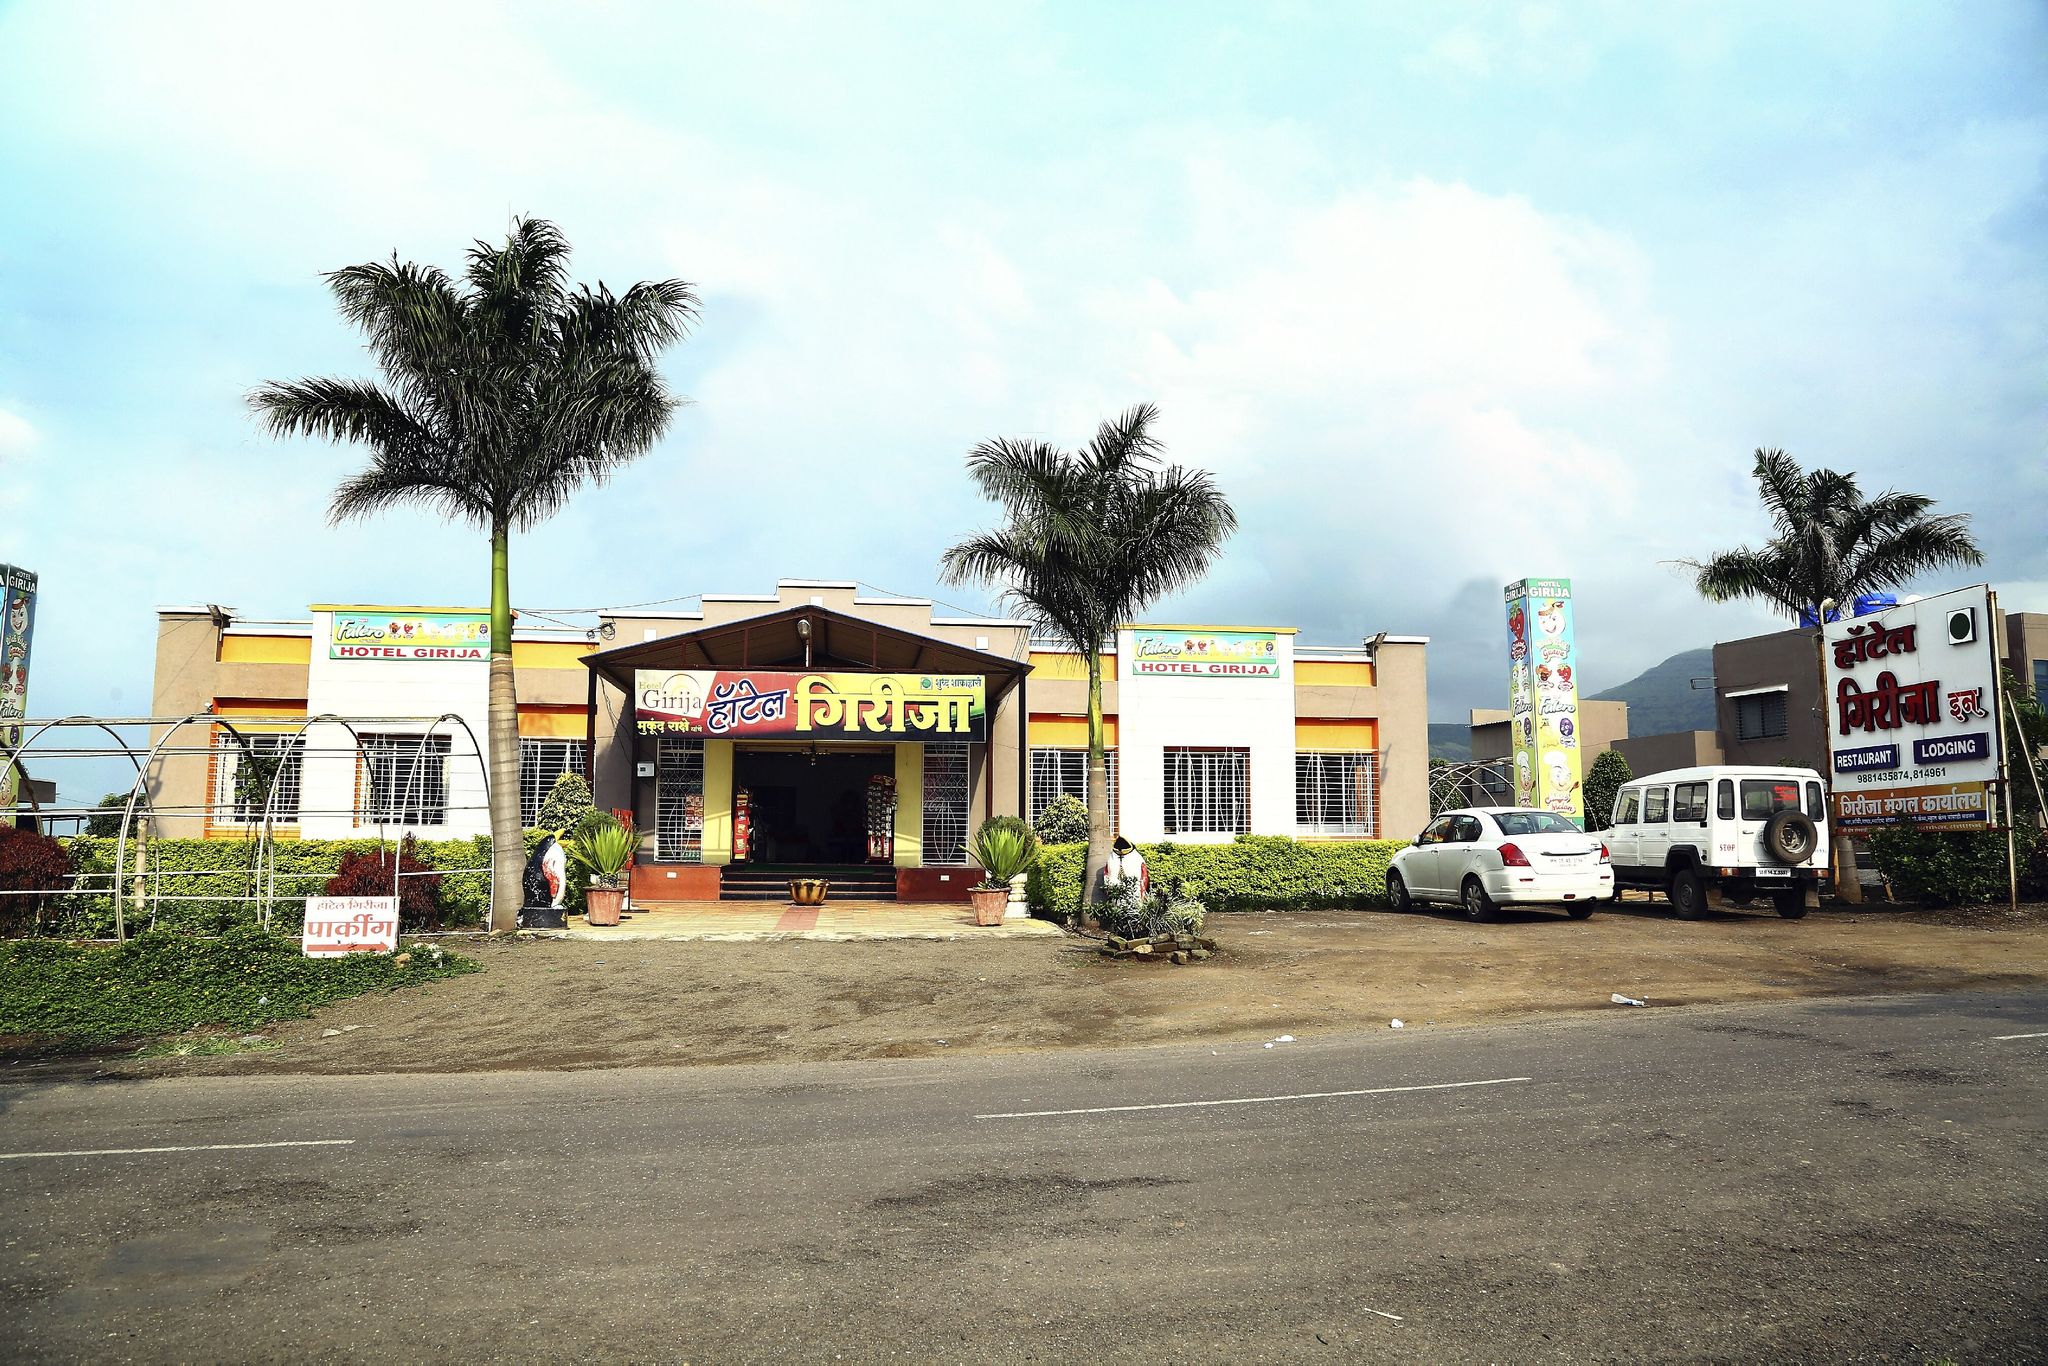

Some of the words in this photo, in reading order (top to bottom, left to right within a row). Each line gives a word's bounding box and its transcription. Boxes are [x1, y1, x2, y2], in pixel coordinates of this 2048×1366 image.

[16, 571, 32, 581] HOTEL
[9, 575, 36, 594] GIRIJA
[1530, 587, 1570, 597] GIRIJA
[1505, 588, 1526, 601] GIRIJA
[341, 647, 407, 657] HOTEL
[414, 648, 482, 658] GIRIJA
[1831, 621, 1917, 669] हॉटेल
[1141, 663, 1203, 673] HOTEL
[1208, 664, 1270, 674] GIRIJA
[639, 681, 662, 690] Hotel
[642, 690, 702, 714] Girija
[706, 679, 790, 732] हॉटेल
[793, 675, 975, 733] गिरीजा
[1836, 671, 1941, 736] गिरीजा
[1837, 750, 1892, 768] RESTAURANT
[1922, 739, 1976, 758] LODGING
[1840, 794, 1882, 816] गिरीजा
[1884, 792, 1919, 813] मंगल
[1921, 787, 1982, 812] कार्यालय
[1720, 843, 1735, 852] STOP
